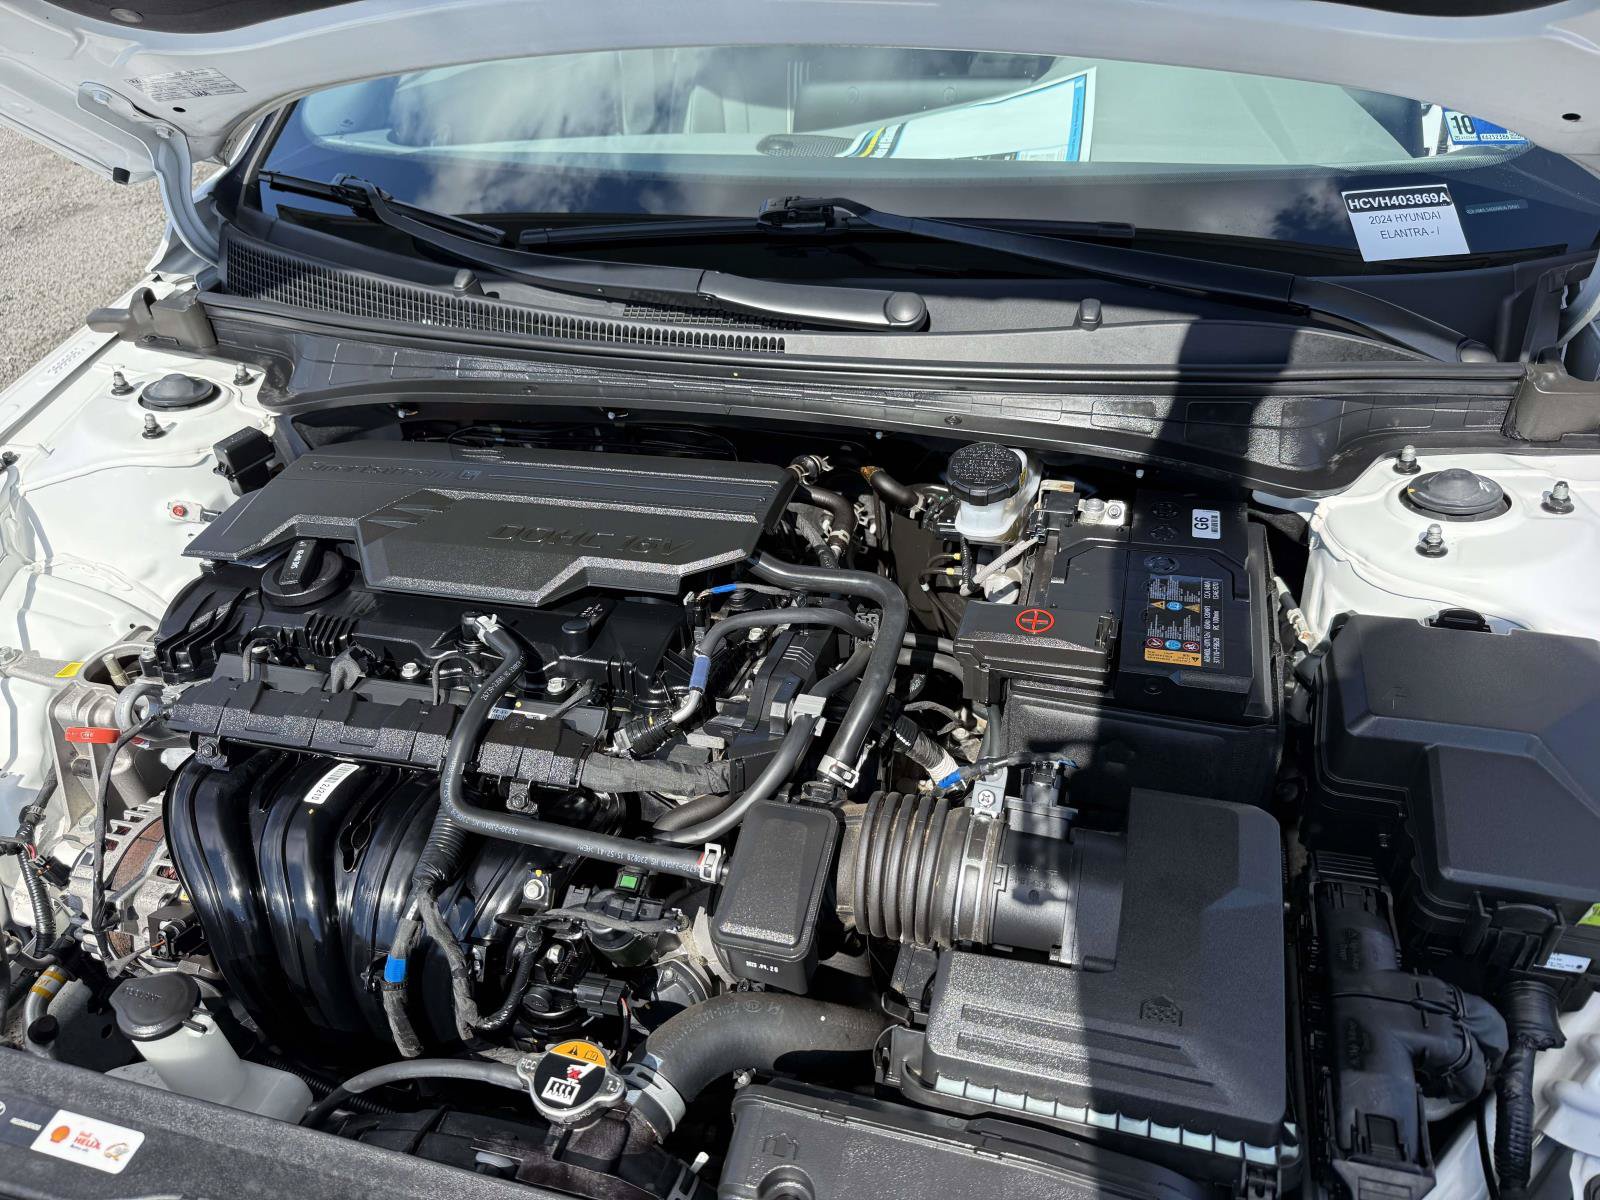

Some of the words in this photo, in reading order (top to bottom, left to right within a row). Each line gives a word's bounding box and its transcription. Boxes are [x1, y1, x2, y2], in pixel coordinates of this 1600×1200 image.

[1451, 115, 1476, 134] 10
[1348, 192, 1450, 210] HCVH403869A
[1369, 215, 1393, 225] 2024
[1395, 210, 1441, 223] HYUNDAI
[1380, 227, 1429, 239] ELANTRA
[1194, 516, 1209, 530] G6
[520, 1058, 537, 1070] HCC
